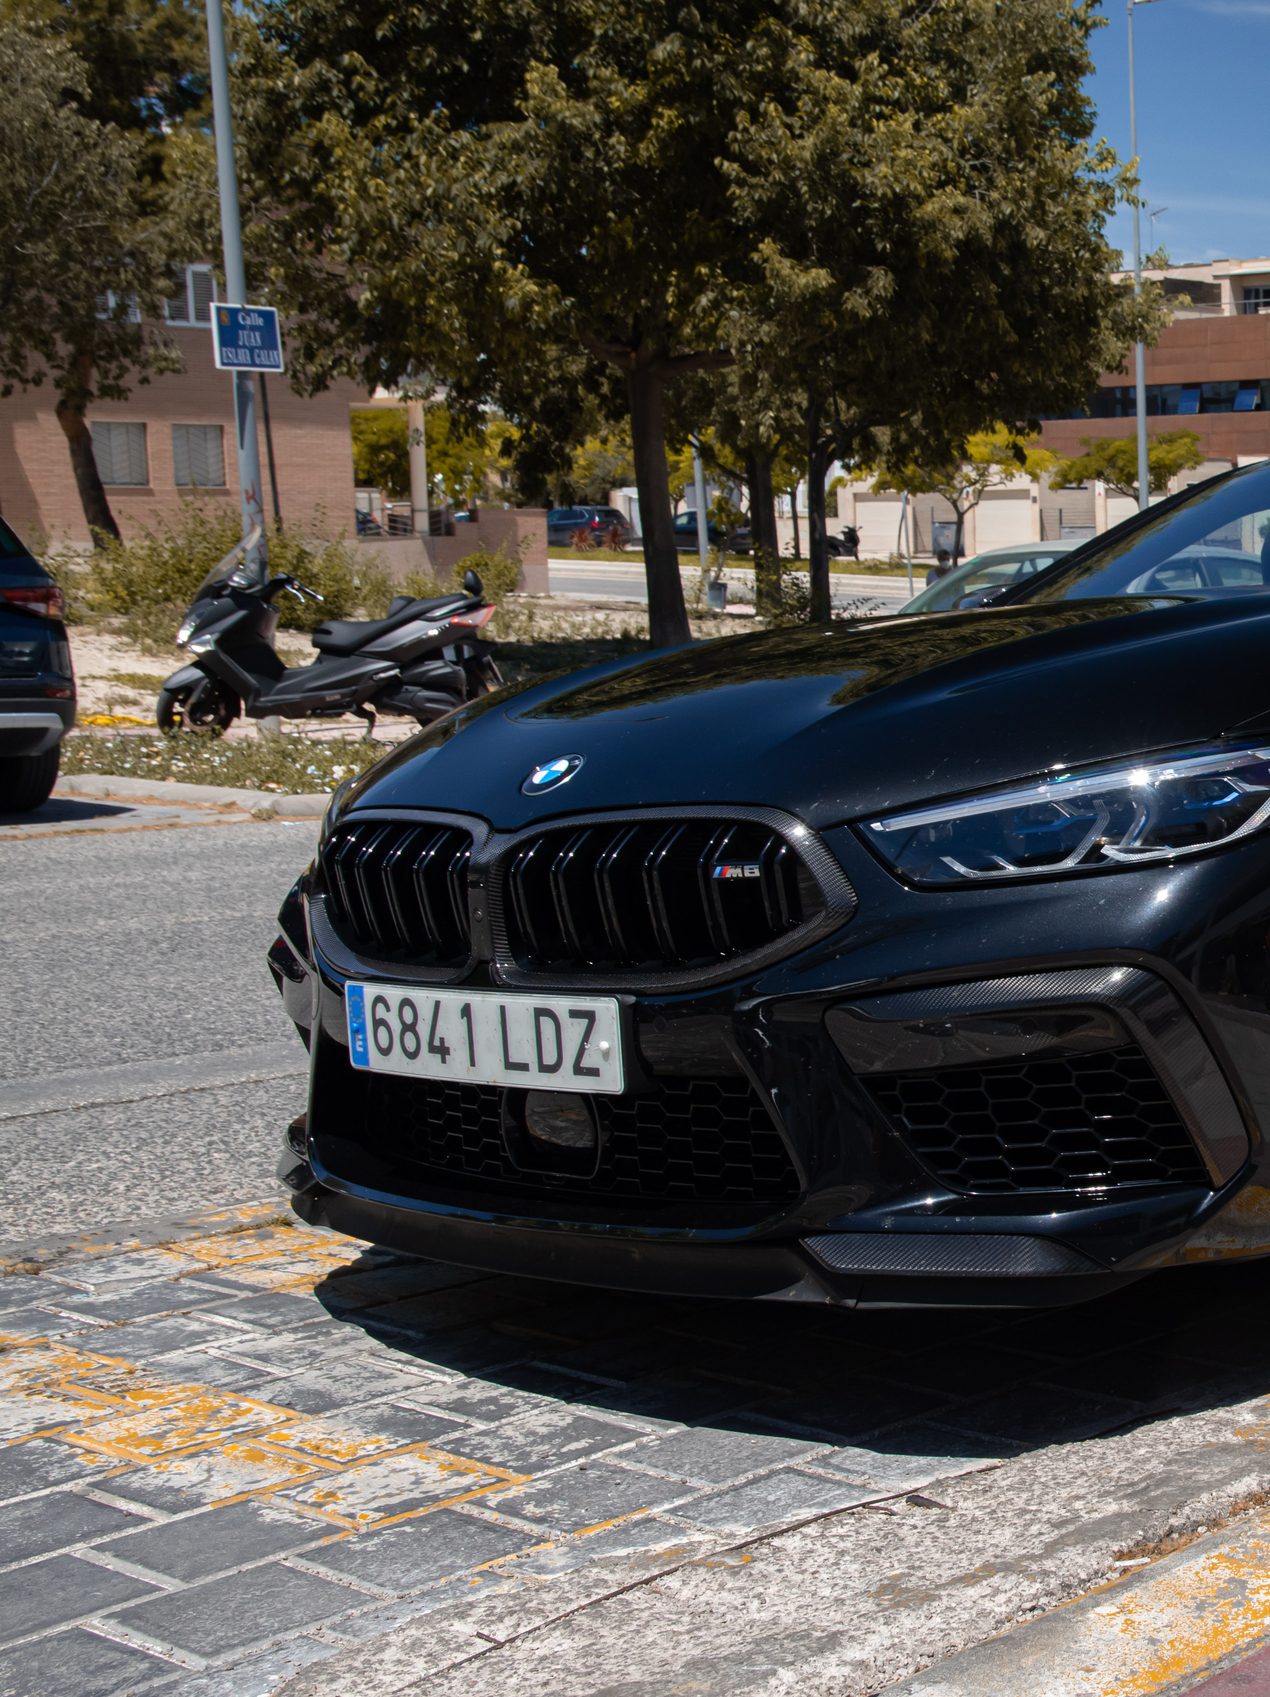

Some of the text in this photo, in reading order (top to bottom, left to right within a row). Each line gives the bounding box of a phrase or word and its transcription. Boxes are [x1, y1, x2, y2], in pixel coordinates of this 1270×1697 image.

[238, 311, 265, 326] Calle
[238, 330, 262, 347] JUAN
[722, 864, 761, 878] M8
[355, 994, 602, 1078] E 6841 LDZ
